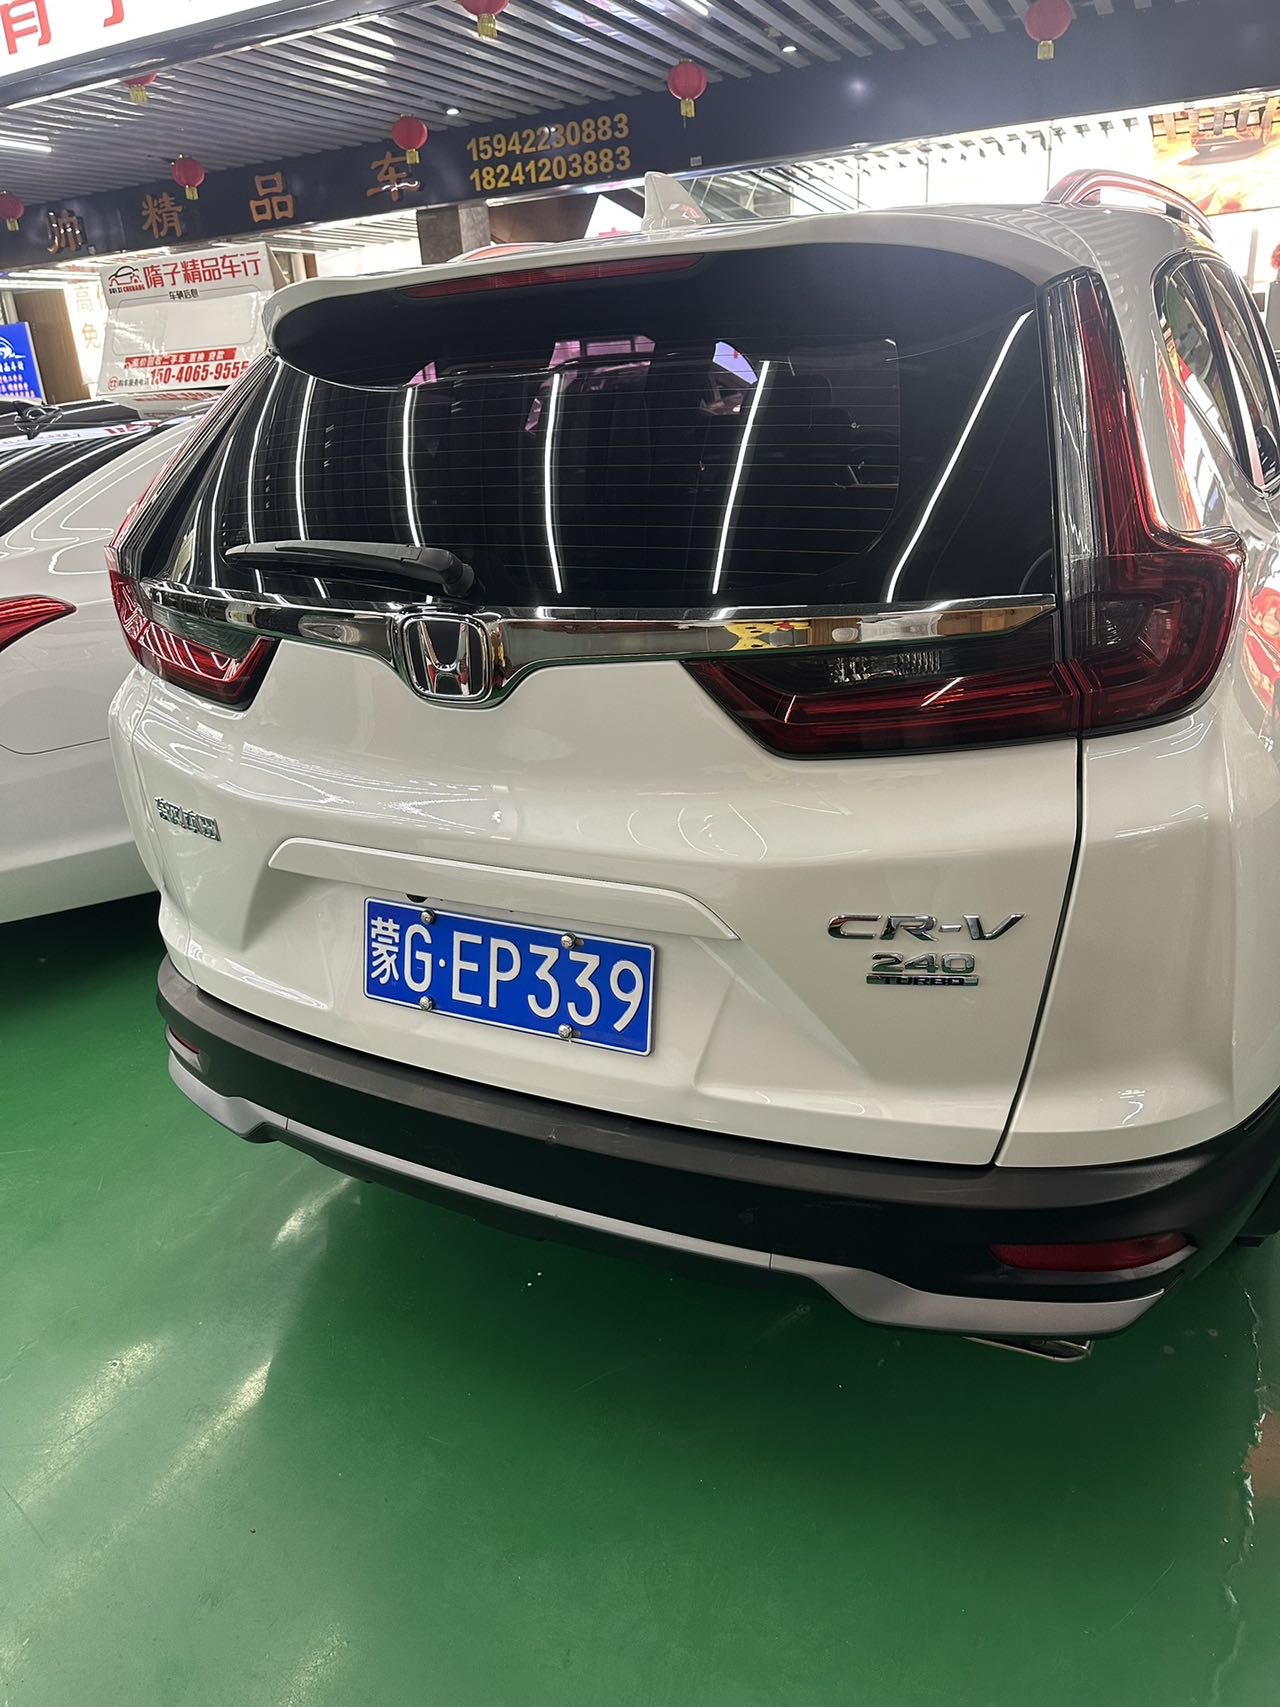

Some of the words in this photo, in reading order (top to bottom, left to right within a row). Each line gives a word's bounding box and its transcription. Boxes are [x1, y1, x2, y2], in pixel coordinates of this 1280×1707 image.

[467, 113, 630, 162] 15942230883
[469, 146, 632, 192] 18241203883
[143, 251, 262, 289] 隋子精品车行
[827, 914, 1025, 942] CR-V
[371, 917, 644, 1032] 蒙G·EP339
[872, 953, 975, 973] 240
[878, 974, 968, 986] TURBO
